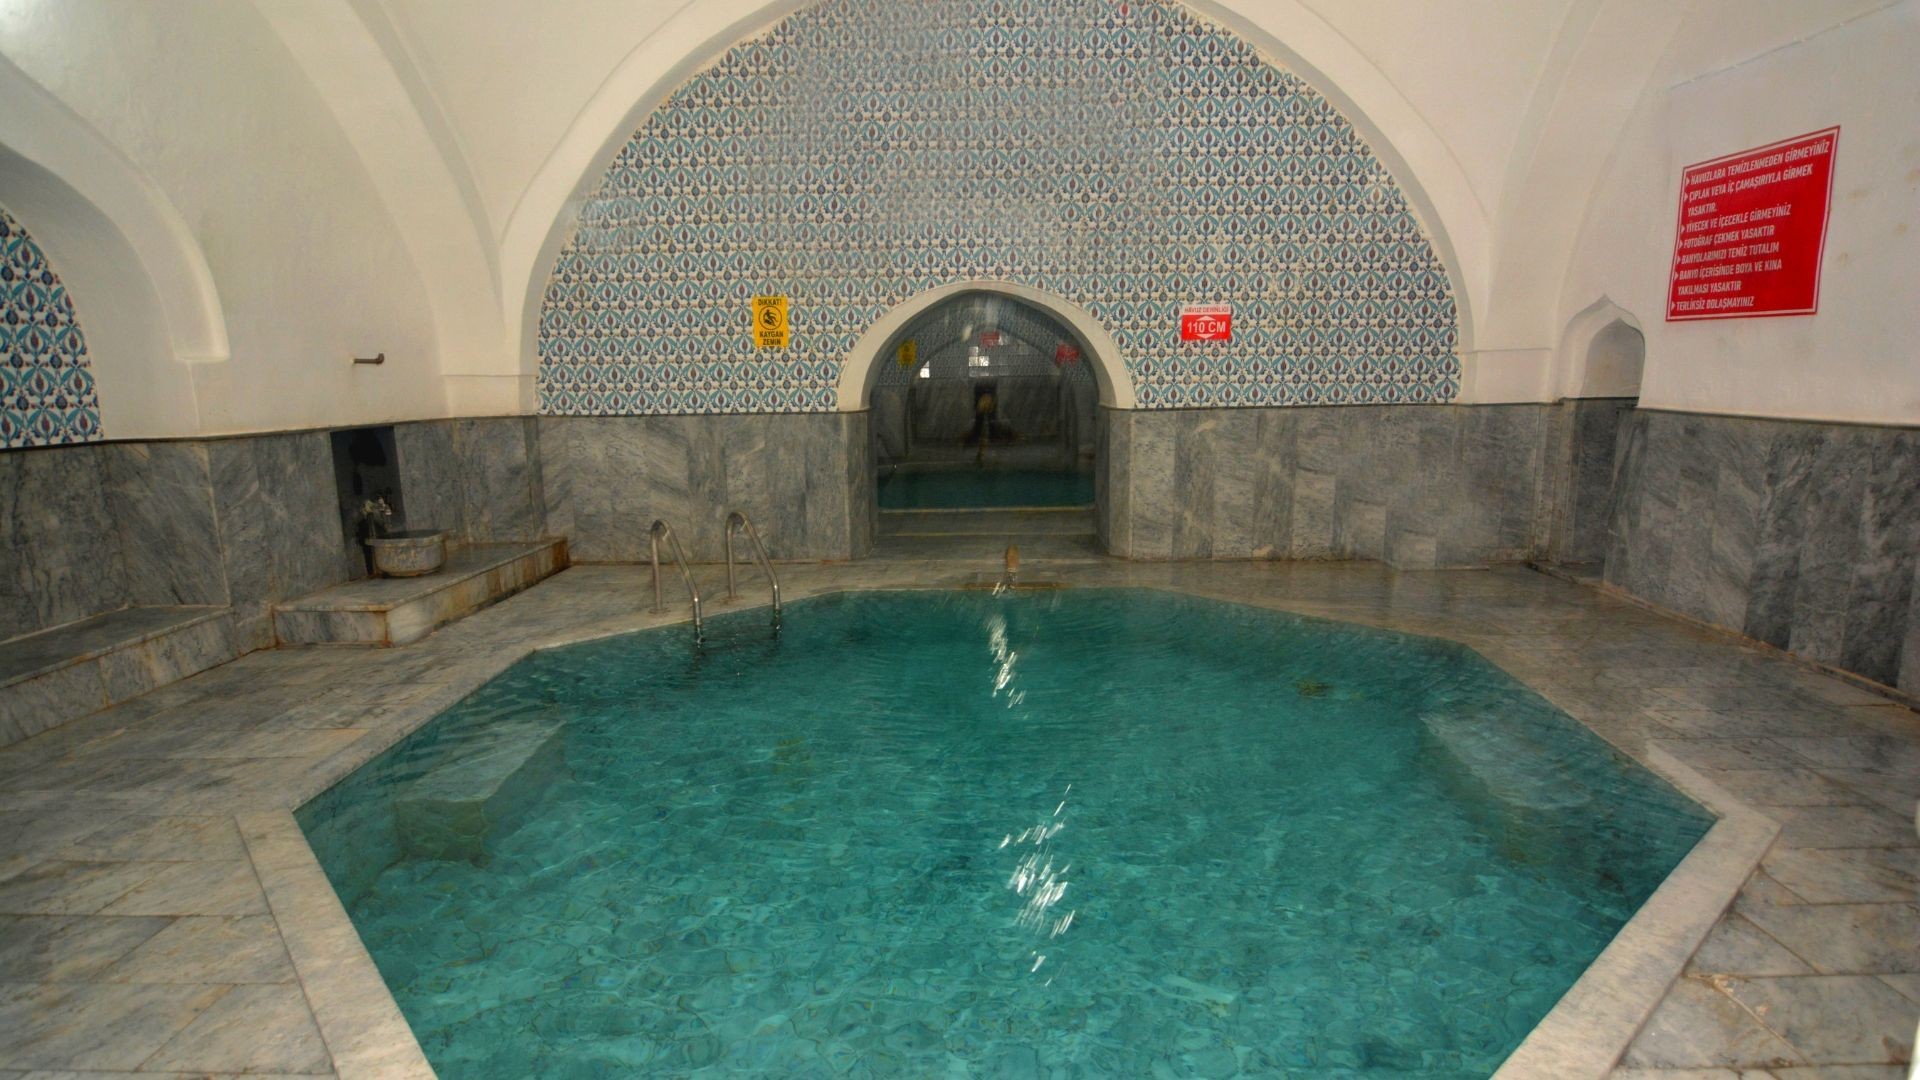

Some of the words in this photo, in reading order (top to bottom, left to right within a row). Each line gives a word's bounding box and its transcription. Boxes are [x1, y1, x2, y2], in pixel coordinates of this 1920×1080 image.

[1691, 171, 1726, 185] HAVUZLARA
[1728, 156, 1783, 176] TEMİZLENMEDEN
[1785, 141, 1830, 162] GİRMEYİNİZ
[1690, 190, 1709, 202] ÇIPLAK
[1711, 186, 1726, 196] VEYA
[1728, 181, 1734, 193] İÇ
[1736, 172, 1781, 190] ÇAMAŞIRIYLA
[1783, 164, 1813, 180] GİRMEK
[1686, 219, 1709, 232] YİYECEK
[1710, 218, 1717, 228] VE
[1719, 211, 1748, 226] İÇECEKLE
[1750, 204, 1791, 221] GİRMEYİNİZ
[1688, 204, 1717, 216] YASAKTIR.
[1684, 236, 1712, 249] FOTOĞRAF
[1714, 230, 1739, 244] ÇEKMEK
[1741, 226, 1775, 240] YASAKTIR
[1681, 250, 1726, 264] BANYOLARIMIZI
[1728, 244, 1747, 258] TEMİZ
[1749, 242, 1779, 255] TUTALIM
[1680, 269, 1698, 280] BANYO
[1700, 263, 1734, 278] İÇERİSİNDE
[1736, 262, 1752, 273] BOYA
[1755, 261, 1763, 271] VE
[1765, 259, 1782, 270] KINA
[1678, 283, 1708, 295] YAKILMASI
[1710, 281, 1742, 293] YASAKTIR
[1677, 297, 1705, 311] TERLİKSİZ
[1706, 296, 1754, 310] DOLAŞMAYINIZ
[1187, 322, 1204, 333] 110
[1209, 321, 1225, 332] CM
